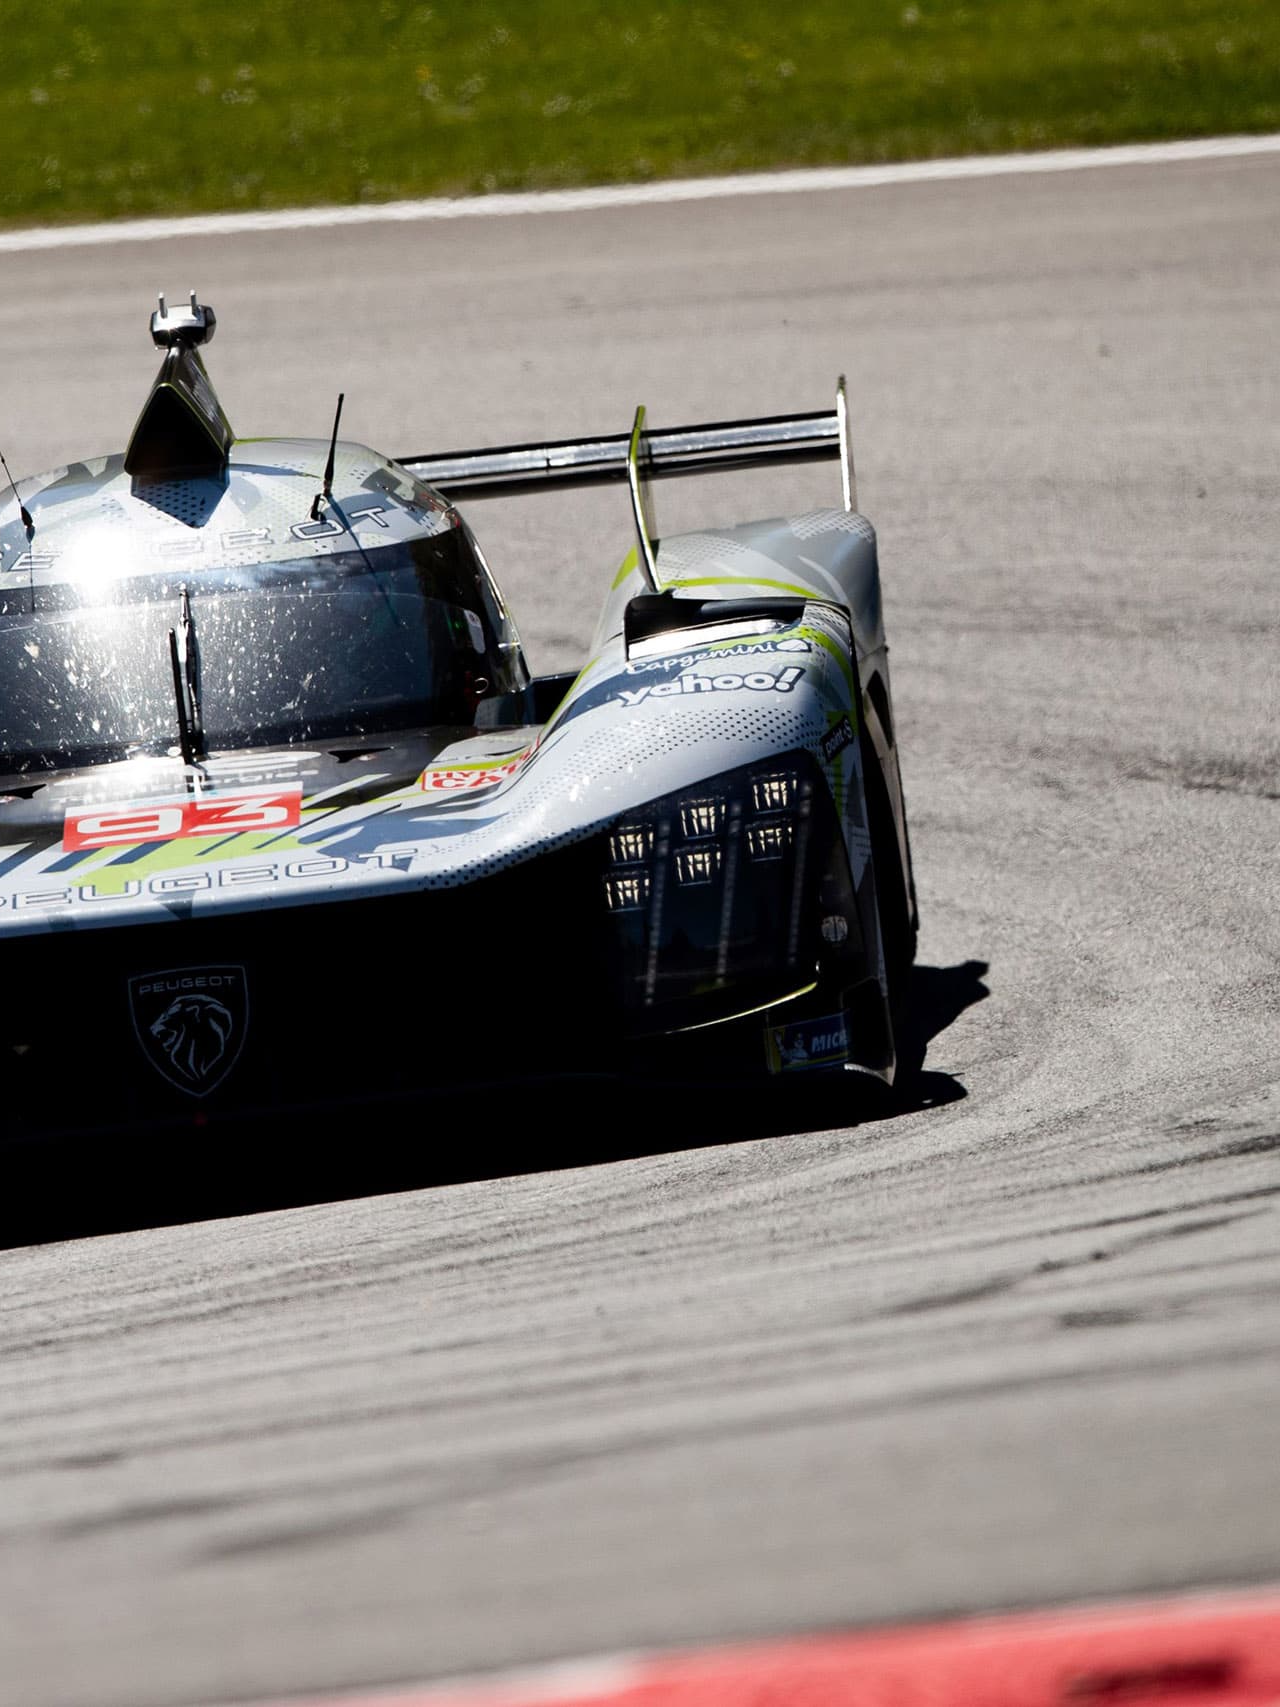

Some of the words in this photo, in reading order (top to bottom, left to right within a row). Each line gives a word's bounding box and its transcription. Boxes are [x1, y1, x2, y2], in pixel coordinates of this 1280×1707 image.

[625, 641, 773, 674] Capgemini
[618, 667, 804, 706] yahoo!
[76, 795, 289, 847] 93
[139, 975, 236, 995] PEUGEOT
